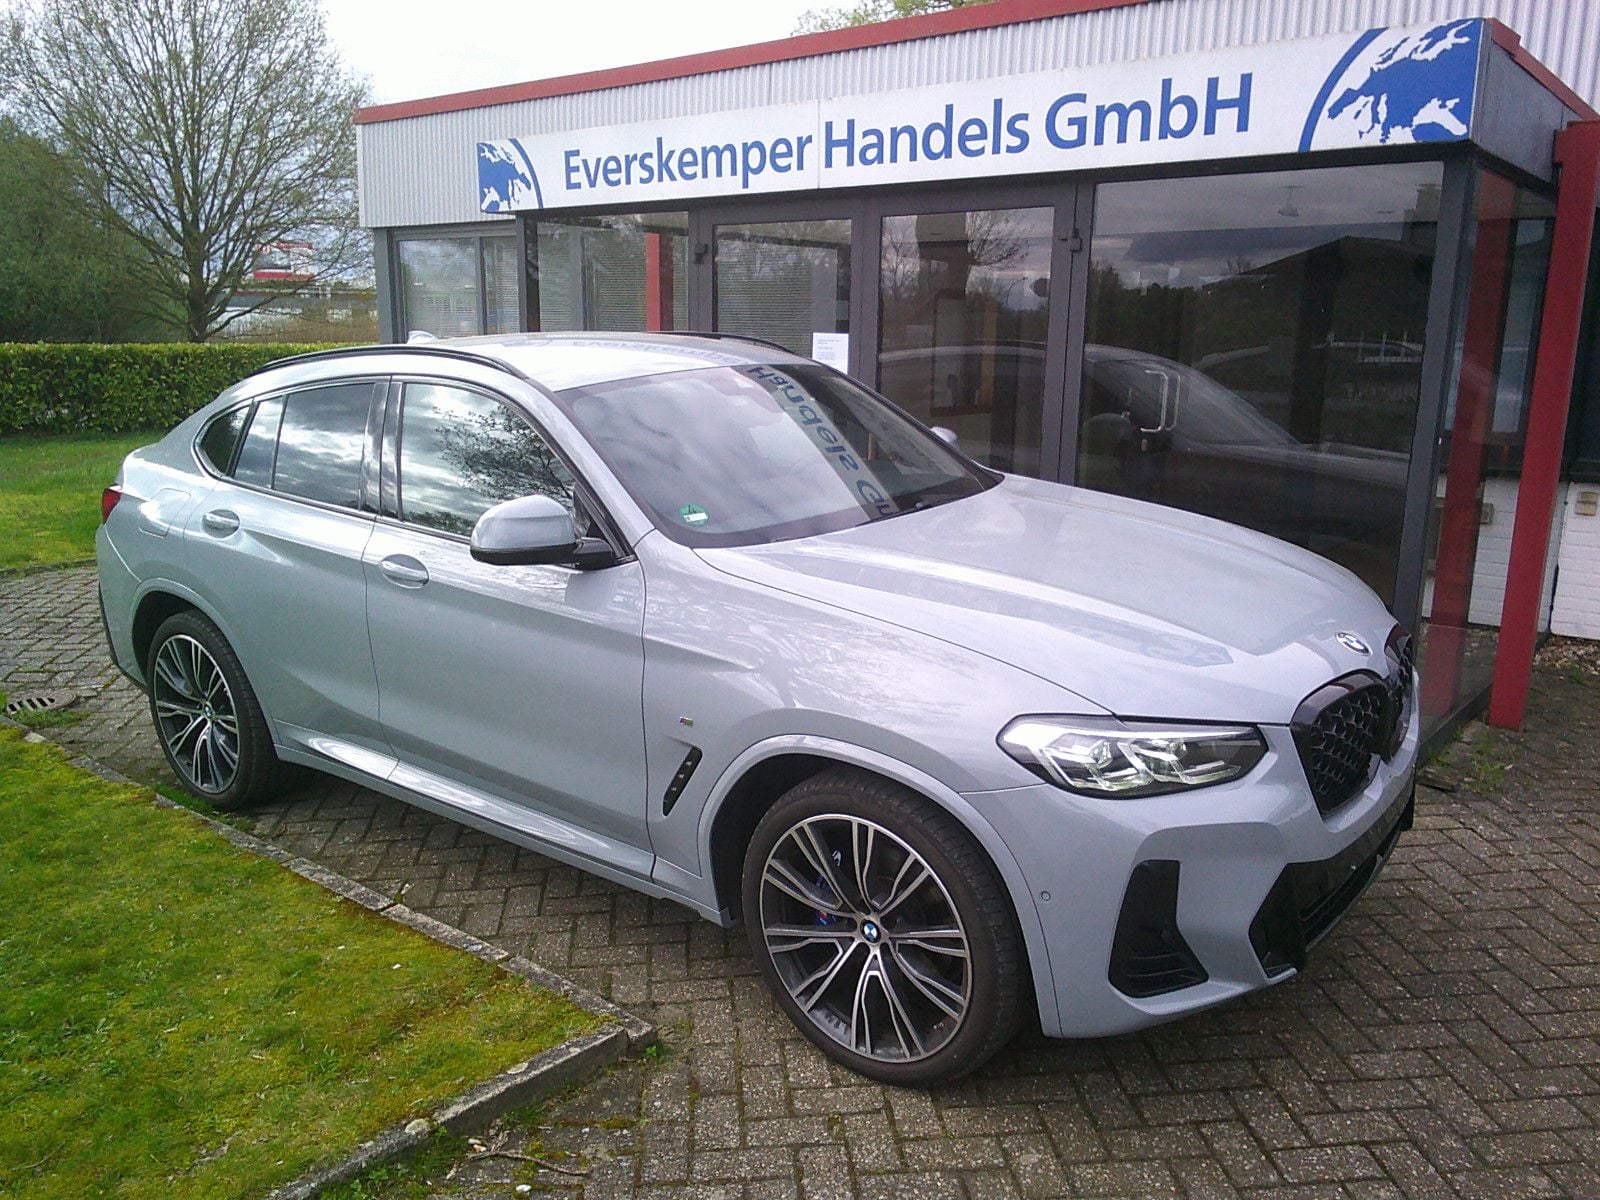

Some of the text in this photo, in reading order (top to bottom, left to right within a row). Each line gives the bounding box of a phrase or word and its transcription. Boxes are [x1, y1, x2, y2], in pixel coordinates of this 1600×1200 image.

[564, 72, 1253, 189] Everskemper Handels GmbH
